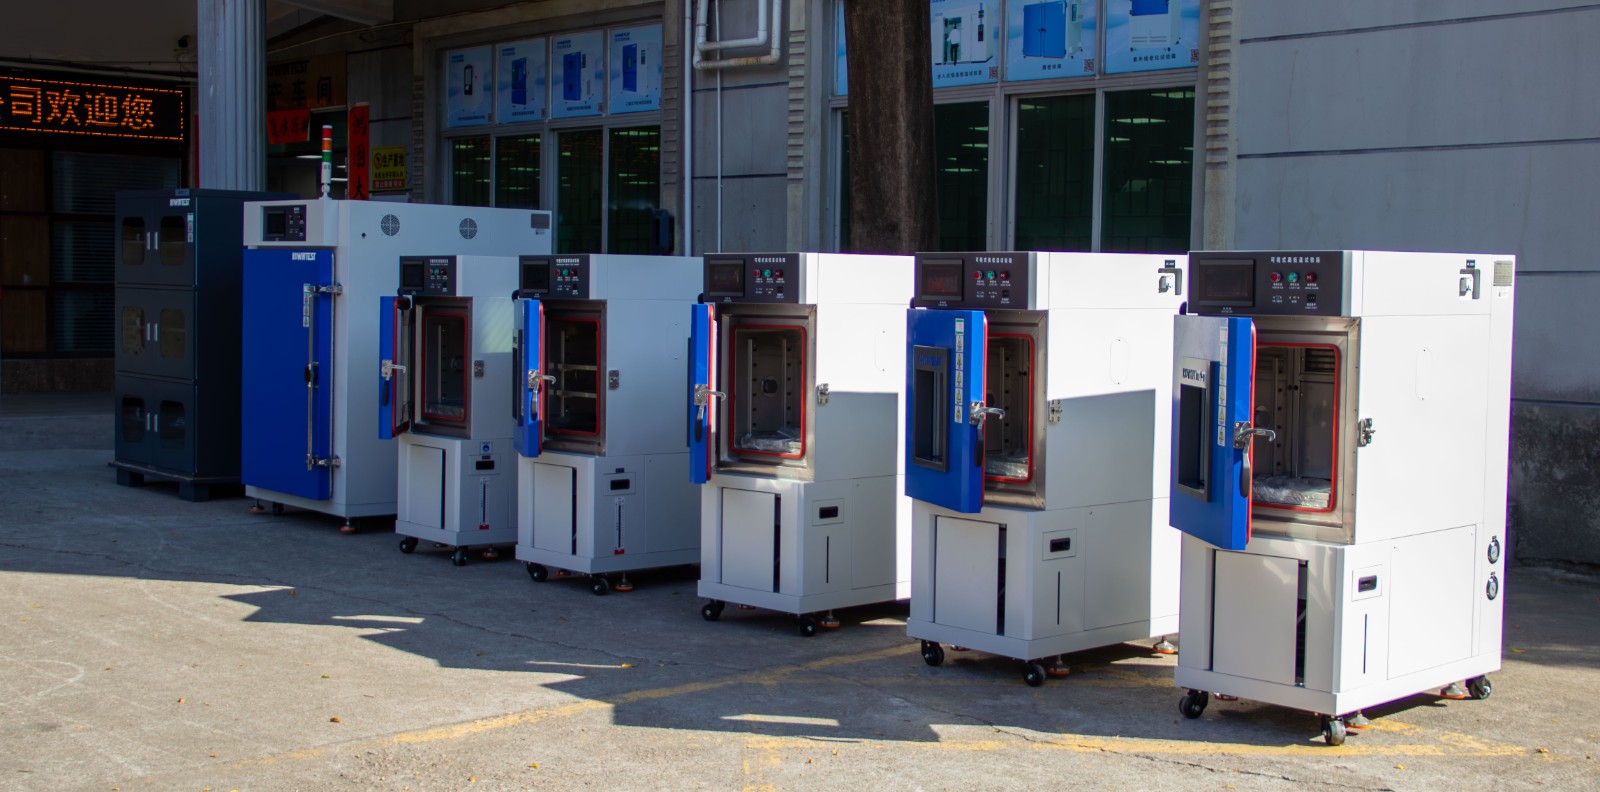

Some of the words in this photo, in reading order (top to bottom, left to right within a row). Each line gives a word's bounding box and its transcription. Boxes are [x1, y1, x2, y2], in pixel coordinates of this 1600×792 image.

[0, 85, 155, 130] 司欢迎您
[1270, 256, 1321, 264] 可程式高低温试验箱
